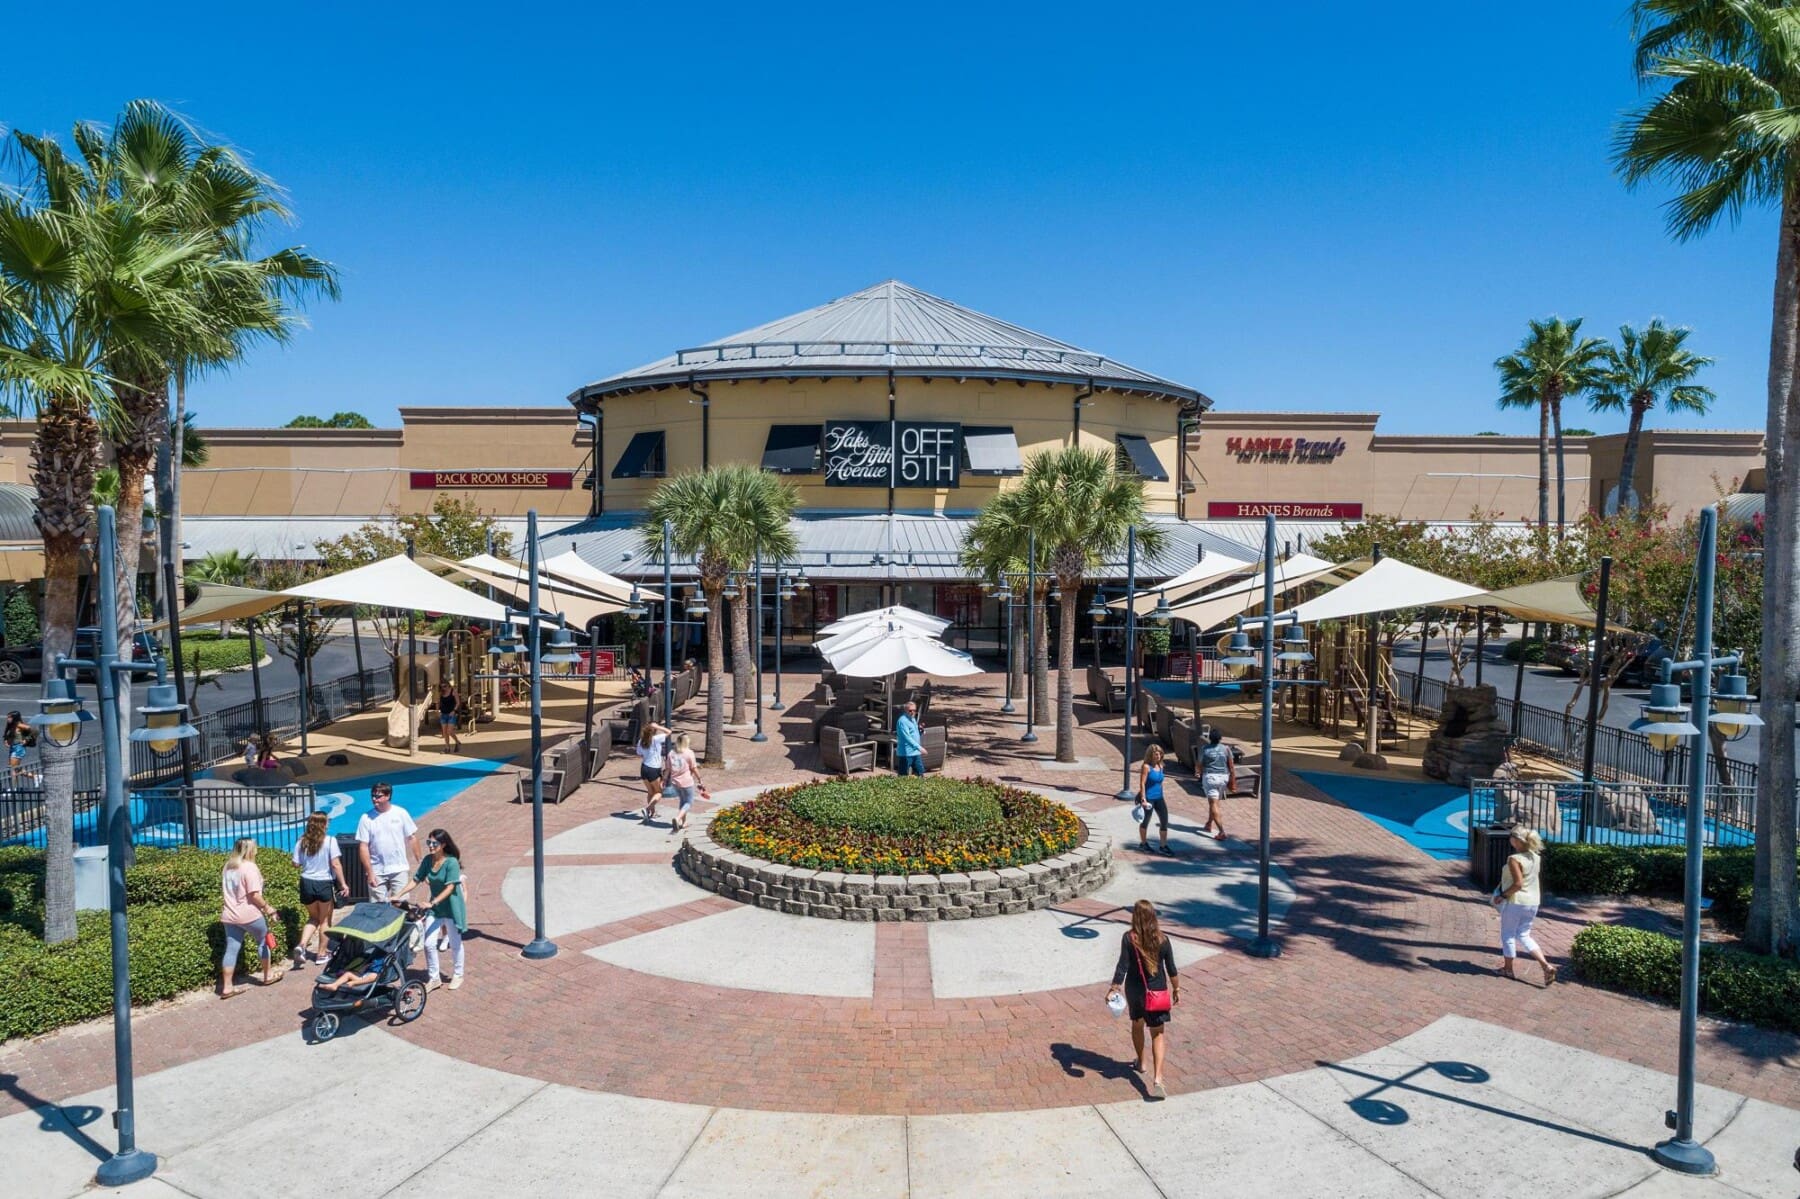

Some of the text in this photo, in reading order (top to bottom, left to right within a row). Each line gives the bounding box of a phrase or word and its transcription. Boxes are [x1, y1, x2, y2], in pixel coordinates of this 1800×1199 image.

[825, 427, 869, 453] Saks
[901, 428, 954, 455] OFF
[1226, 437, 1346, 451] HANES Brands
[848, 444, 892, 466] Fifth
[436, 473, 548, 484] RACK ROOM SHOES
[825, 456, 887, 480] Avenue
[901, 455, 954, 481] 5TH
[1238, 505, 1334, 517] HANES Brands
